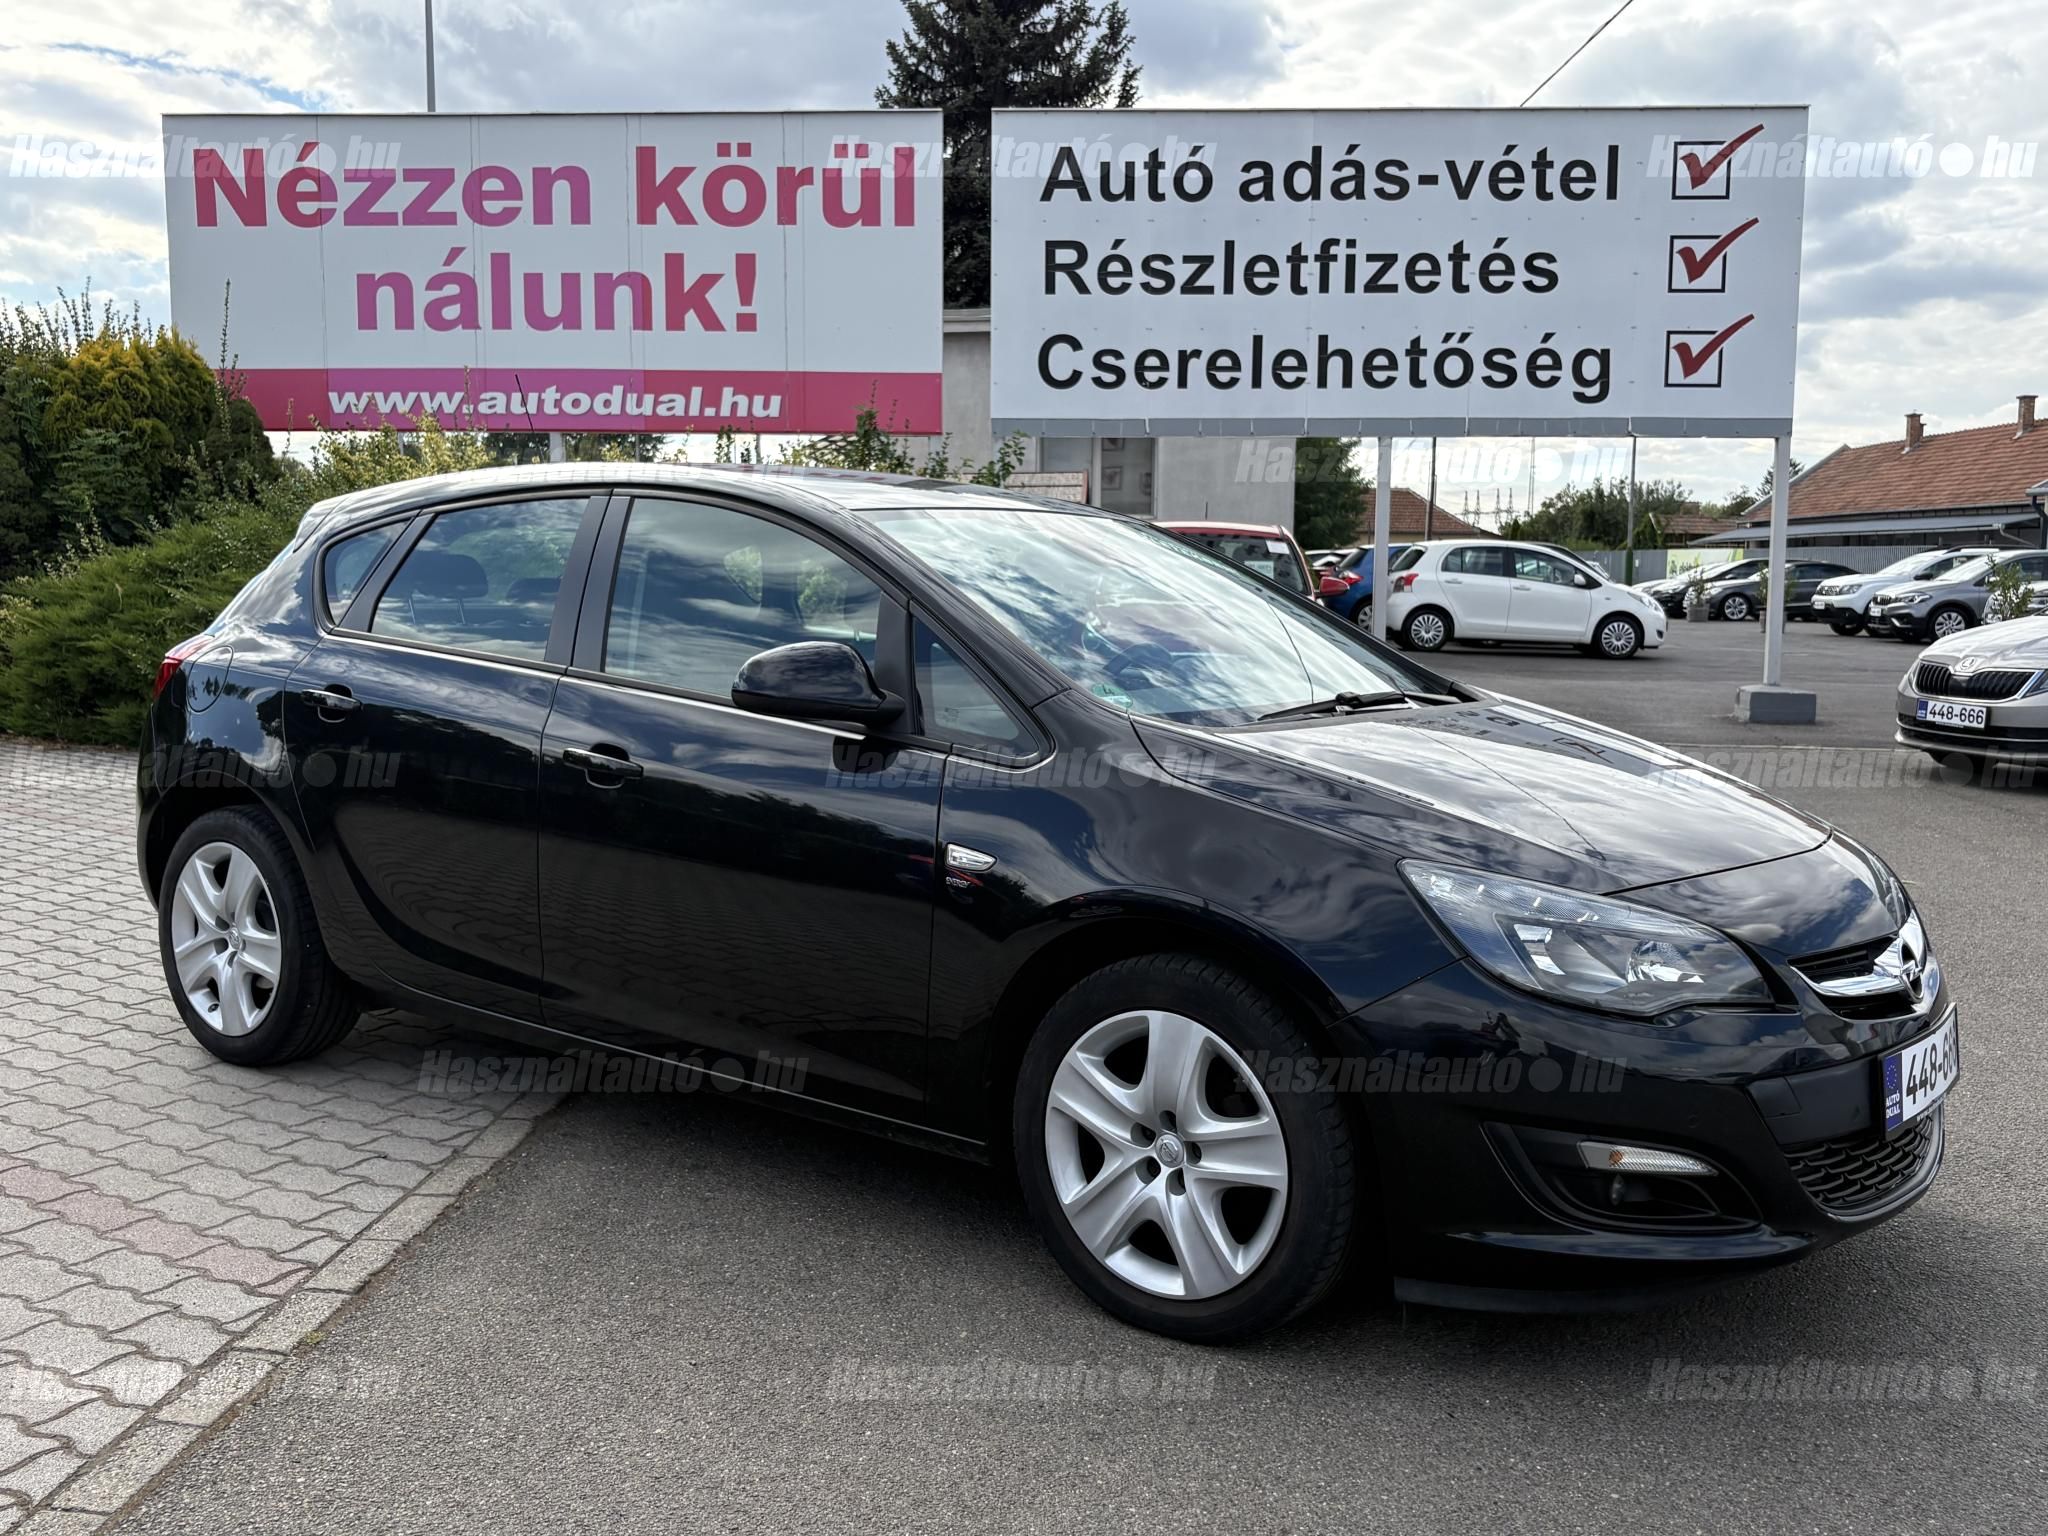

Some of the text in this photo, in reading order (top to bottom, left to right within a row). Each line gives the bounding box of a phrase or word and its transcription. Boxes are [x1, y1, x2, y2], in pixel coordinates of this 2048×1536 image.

[195, 142, 914, 228] Nézzen körül
[1040, 143, 1619, 203] Autó adás-vétel
[356, 246, 757, 332] nálunk!
[1045, 236, 1559, 295] Részletfizetés
[1038, 331, 1611, 404] Cserelehetőség
[328, 384, 782, 418] www.autodual.hu
[1929, 703, 1984, 725] 448-666
[1886, 1089, 1900, 1108] AUTÓ
